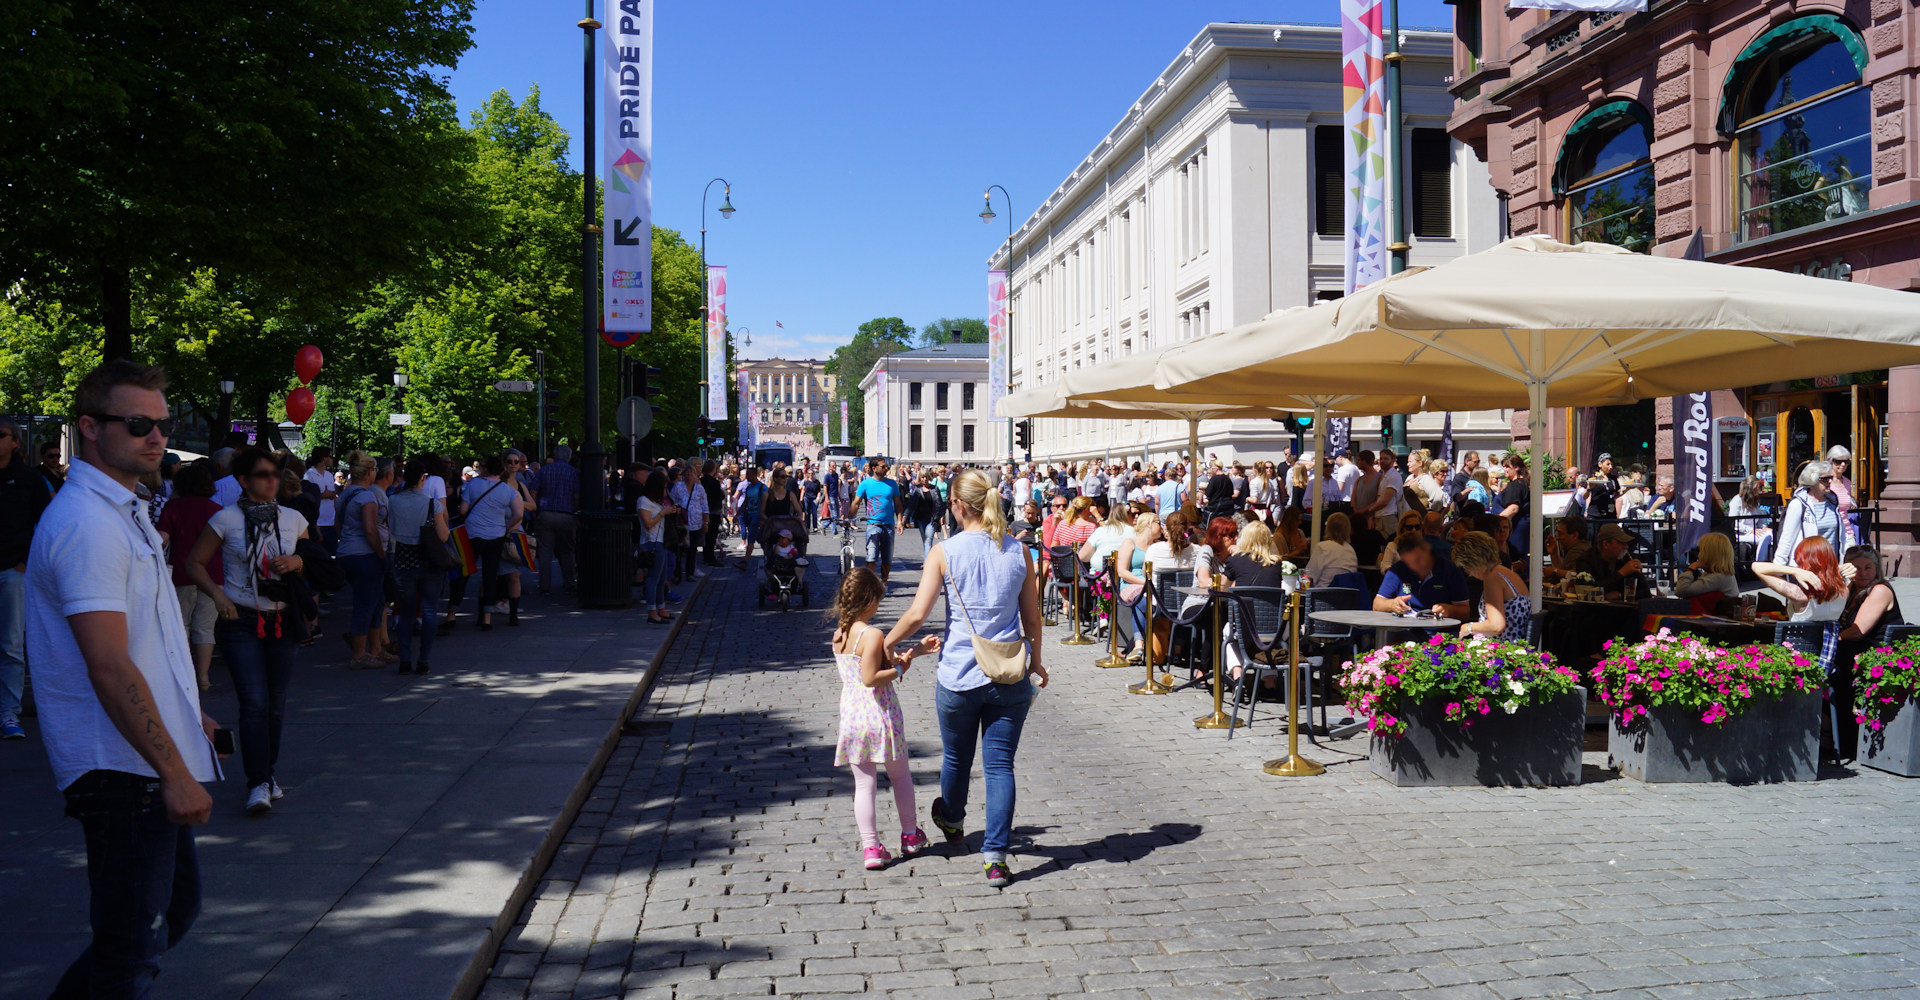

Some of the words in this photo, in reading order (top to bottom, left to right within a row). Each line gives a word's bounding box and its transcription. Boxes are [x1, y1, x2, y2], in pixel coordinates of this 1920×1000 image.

[619, 46, 640, 139] PRIDE
[1816, 375, 1838, 387] OSLO
[1684, 445, 1708, 523] Hard
